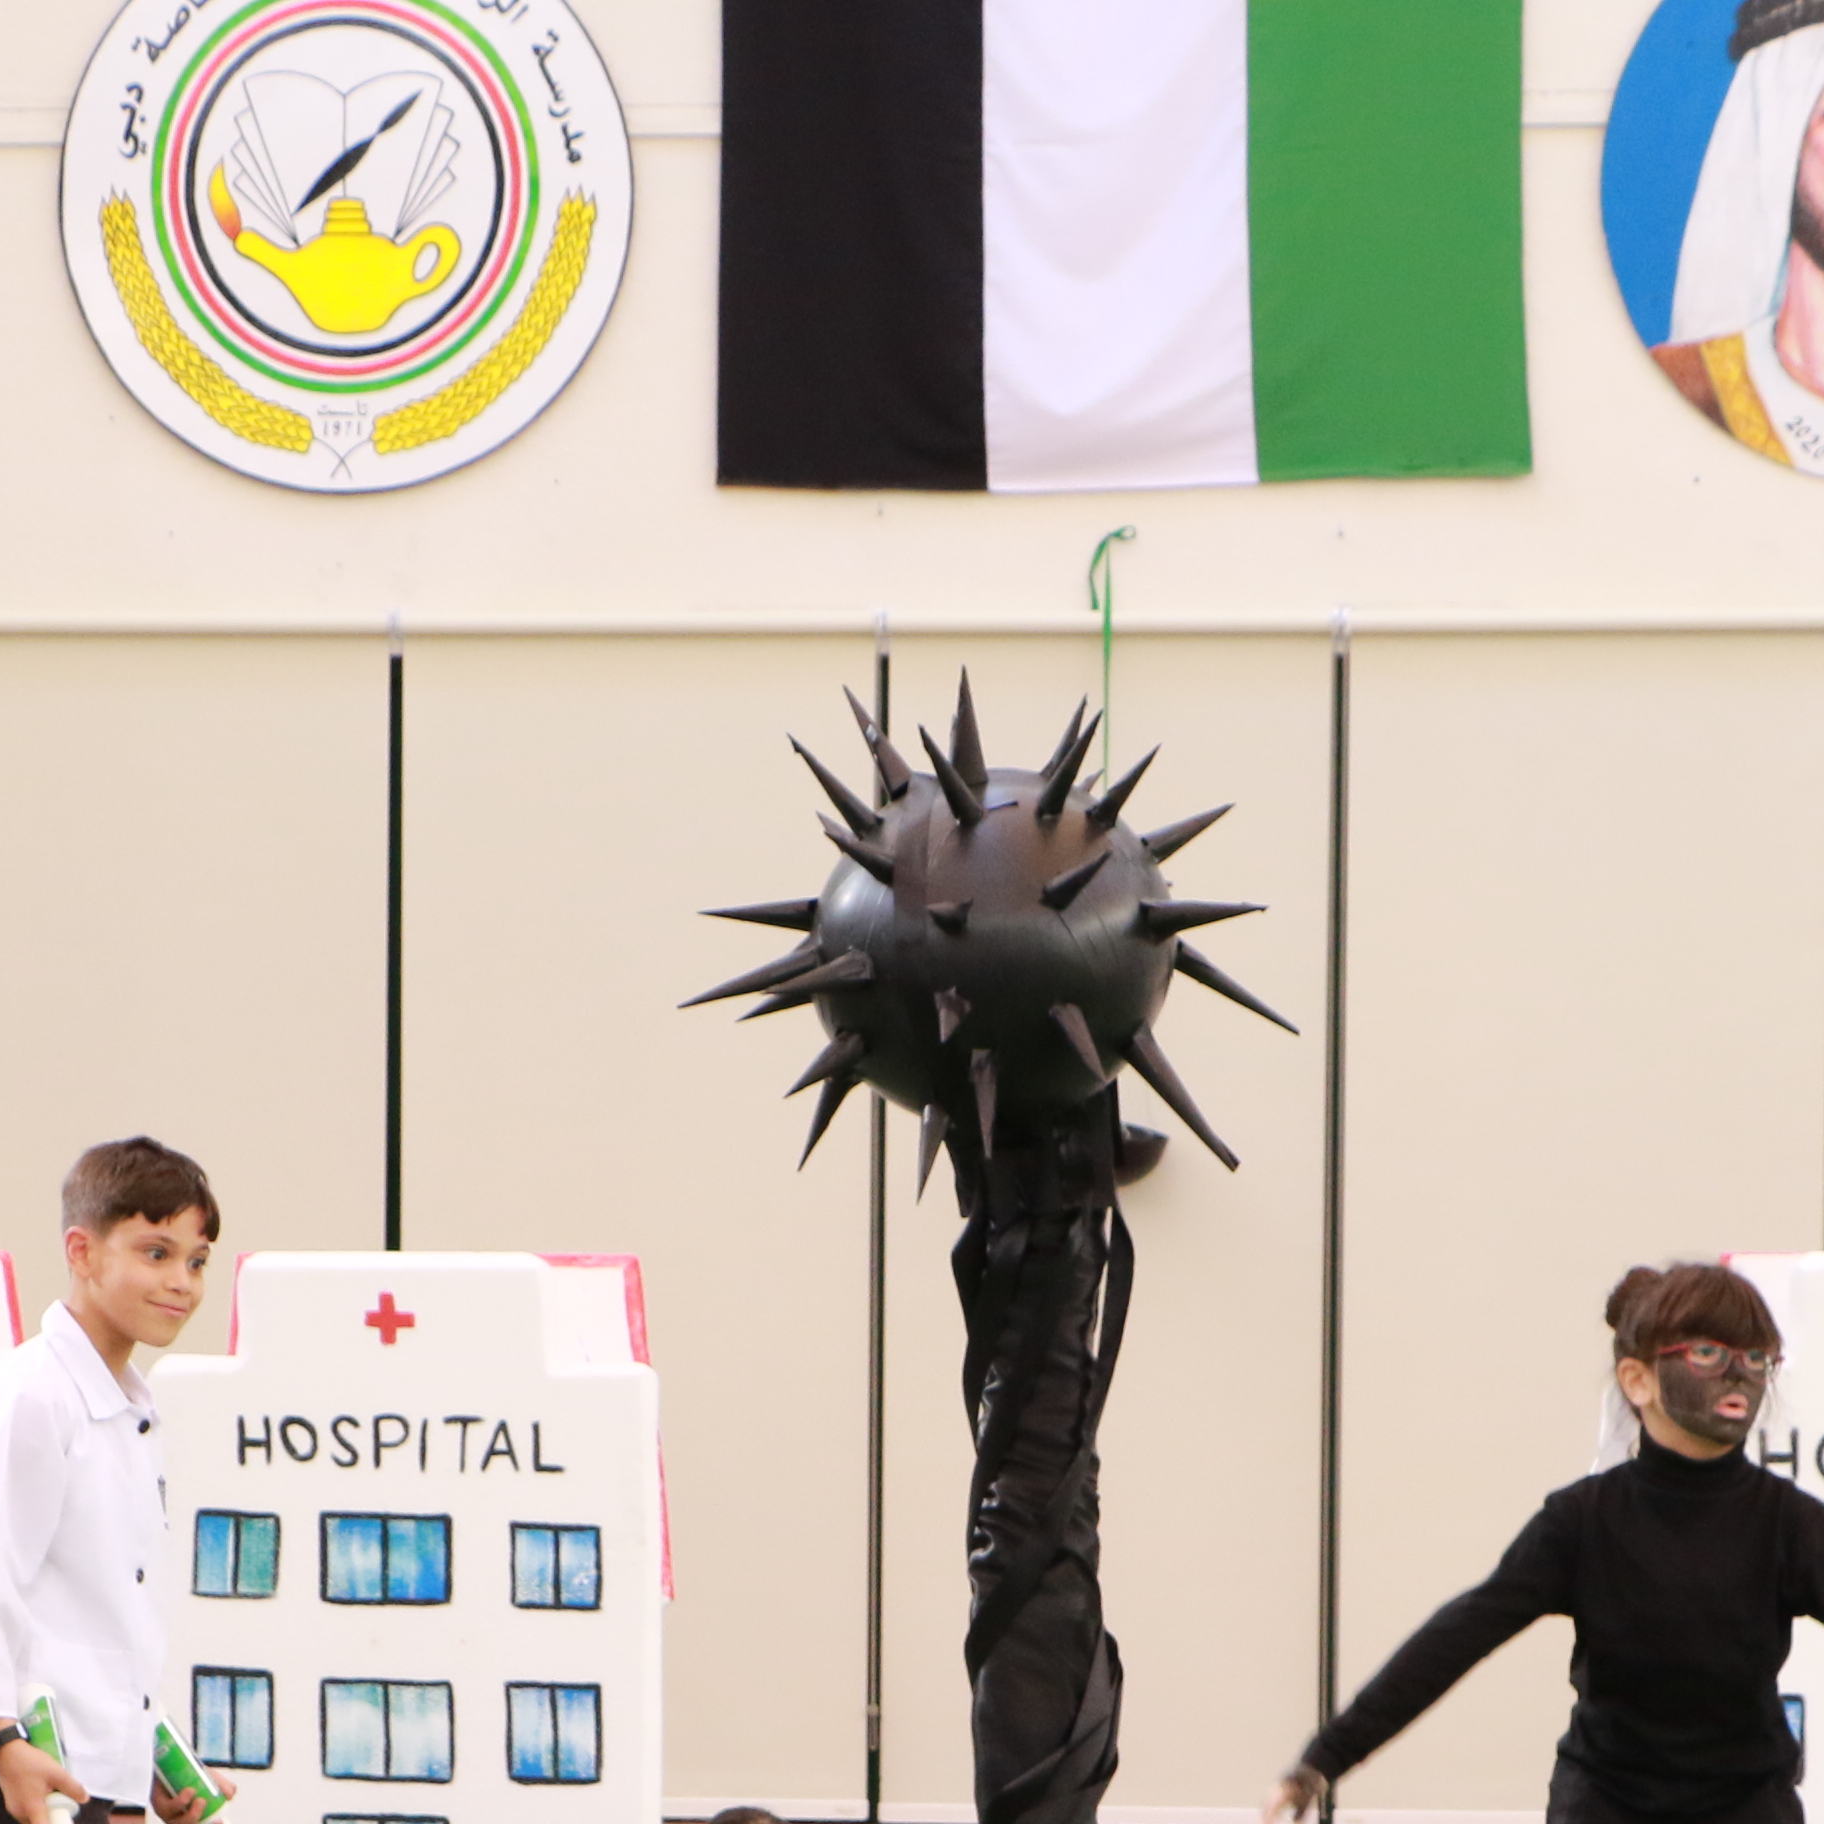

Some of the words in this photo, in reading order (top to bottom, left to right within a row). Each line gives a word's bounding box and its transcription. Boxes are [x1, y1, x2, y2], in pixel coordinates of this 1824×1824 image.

[118, 81, 147, 159] دبي
[532, 28, 585, 164] مدرسة
[323, 420, 361, 436] 1971
[237, 1413, 565, 1474] HOSPITAL
